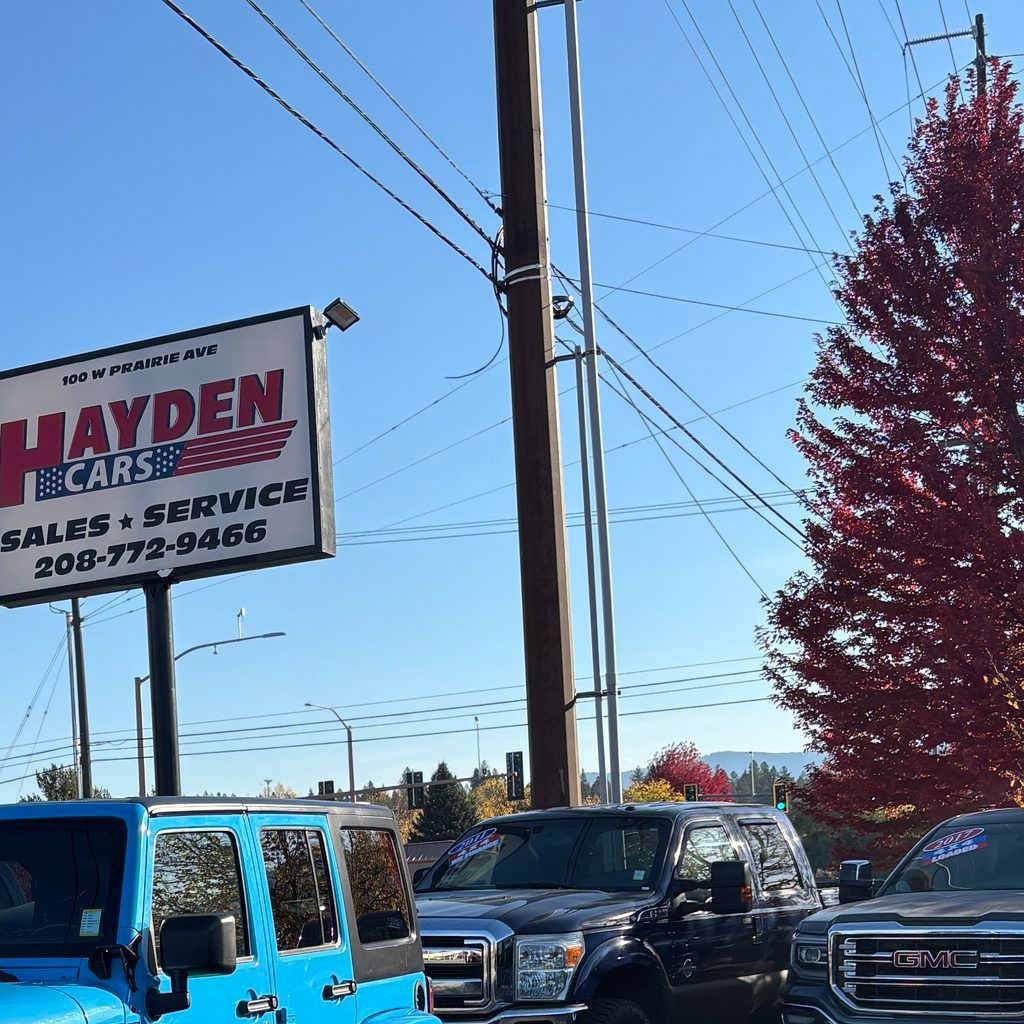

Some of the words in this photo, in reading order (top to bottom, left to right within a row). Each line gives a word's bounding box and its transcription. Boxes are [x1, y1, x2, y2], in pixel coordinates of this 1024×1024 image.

[62, 374, 88, 386] 100
[92, 367, 107, 379] W
[109, 352, 181, 377] PRAIRIE
[183, 344, 218, 361] AVE
[64, 449, 154, 493] CARS
[0, 514, 110, 552] SALES
[142, 478, 309, 528] SERVICE
[34, 519, 267, 579] 208-772-9466
[931, 844, 979, 863] LOADED
[893, 950, 977, 969] GMC
